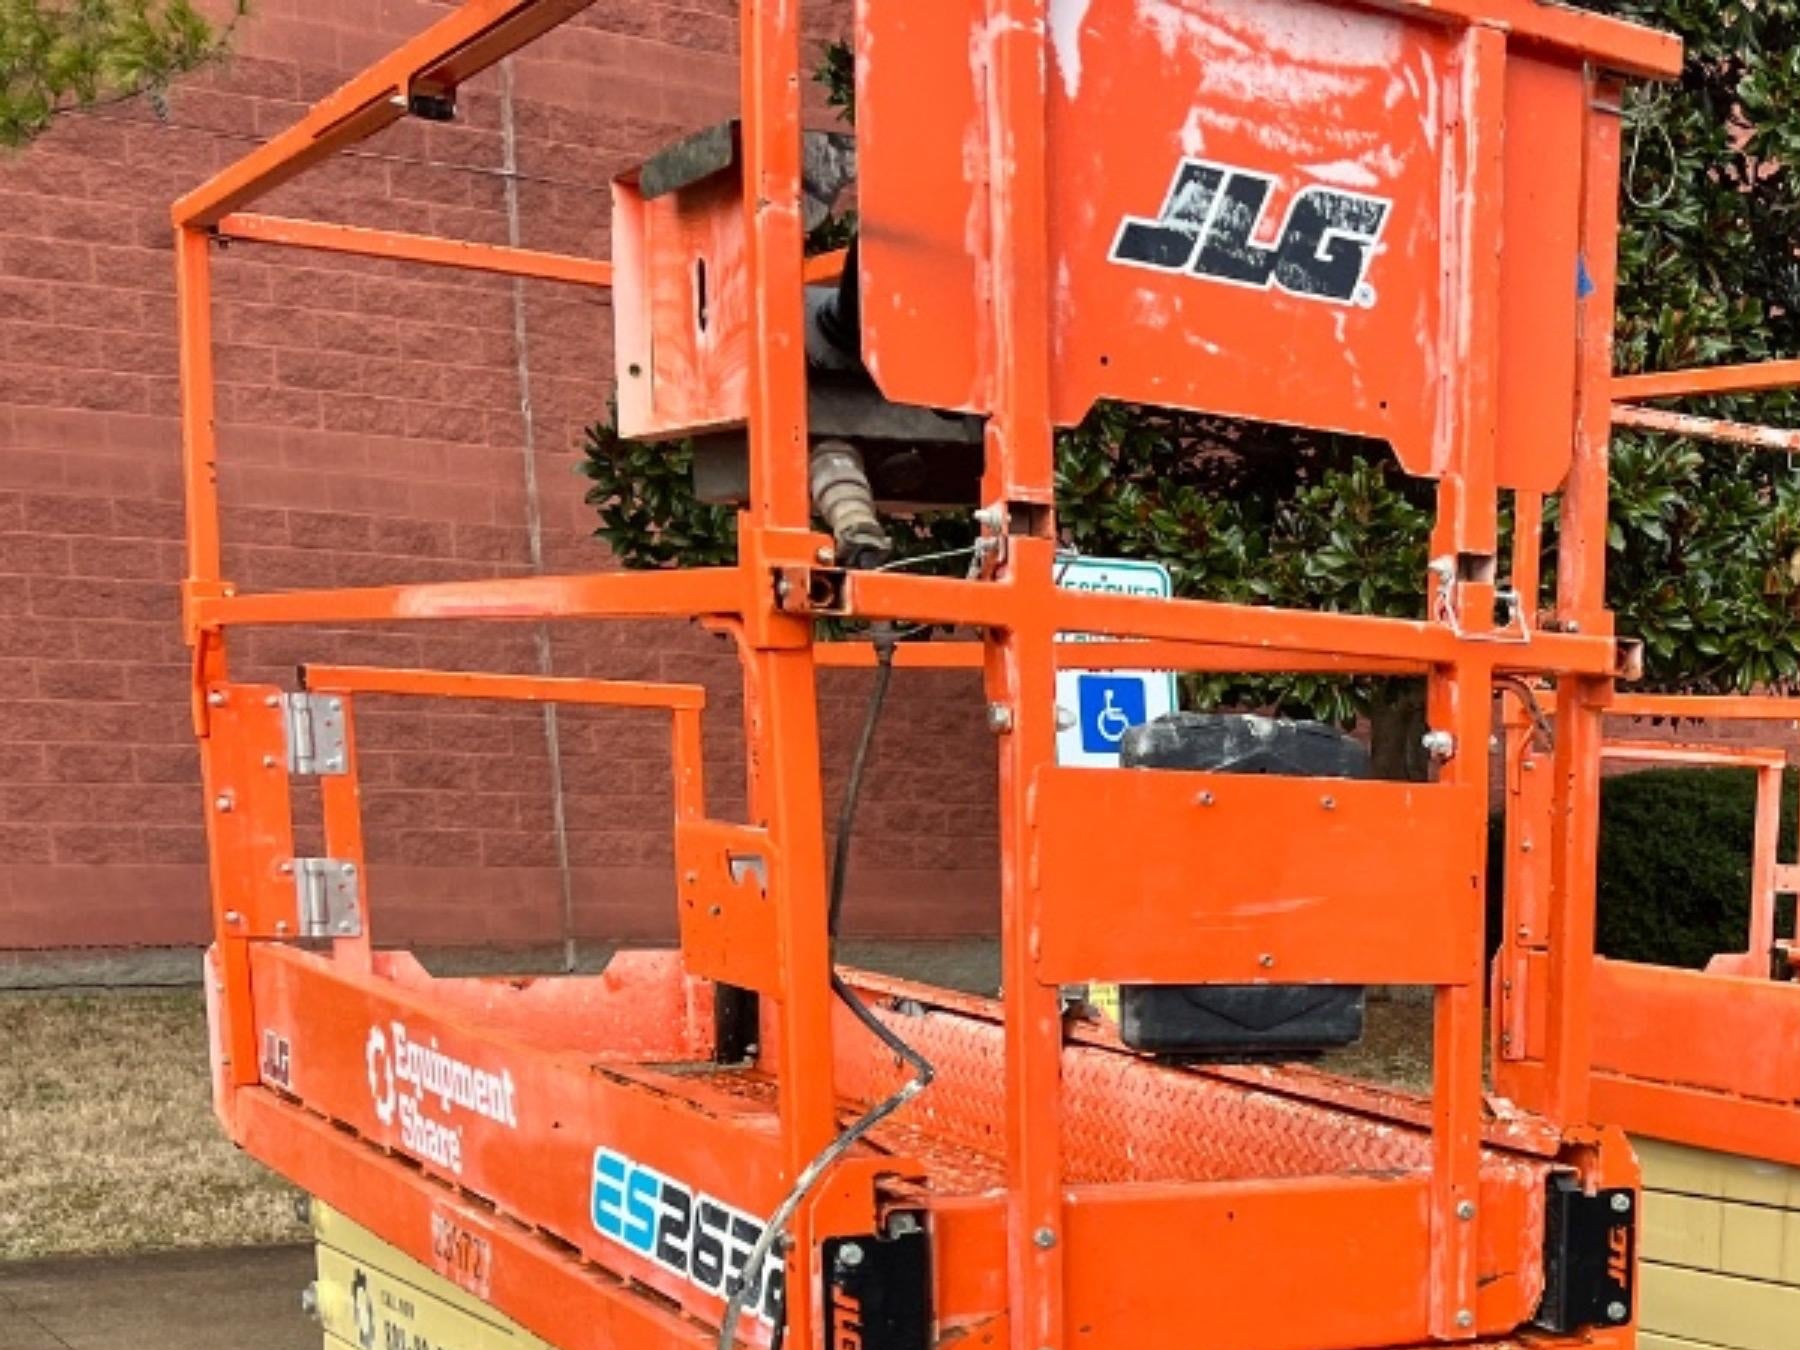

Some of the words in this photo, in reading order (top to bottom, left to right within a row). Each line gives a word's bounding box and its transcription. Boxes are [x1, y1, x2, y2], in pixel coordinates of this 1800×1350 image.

[1108, 156, 1392, 305] JLG
[391, 1021, 517, 1129] Equipment
[400, 1094, 462, 1174] Share
[1608, 1226, 1626, 1288] JLG
